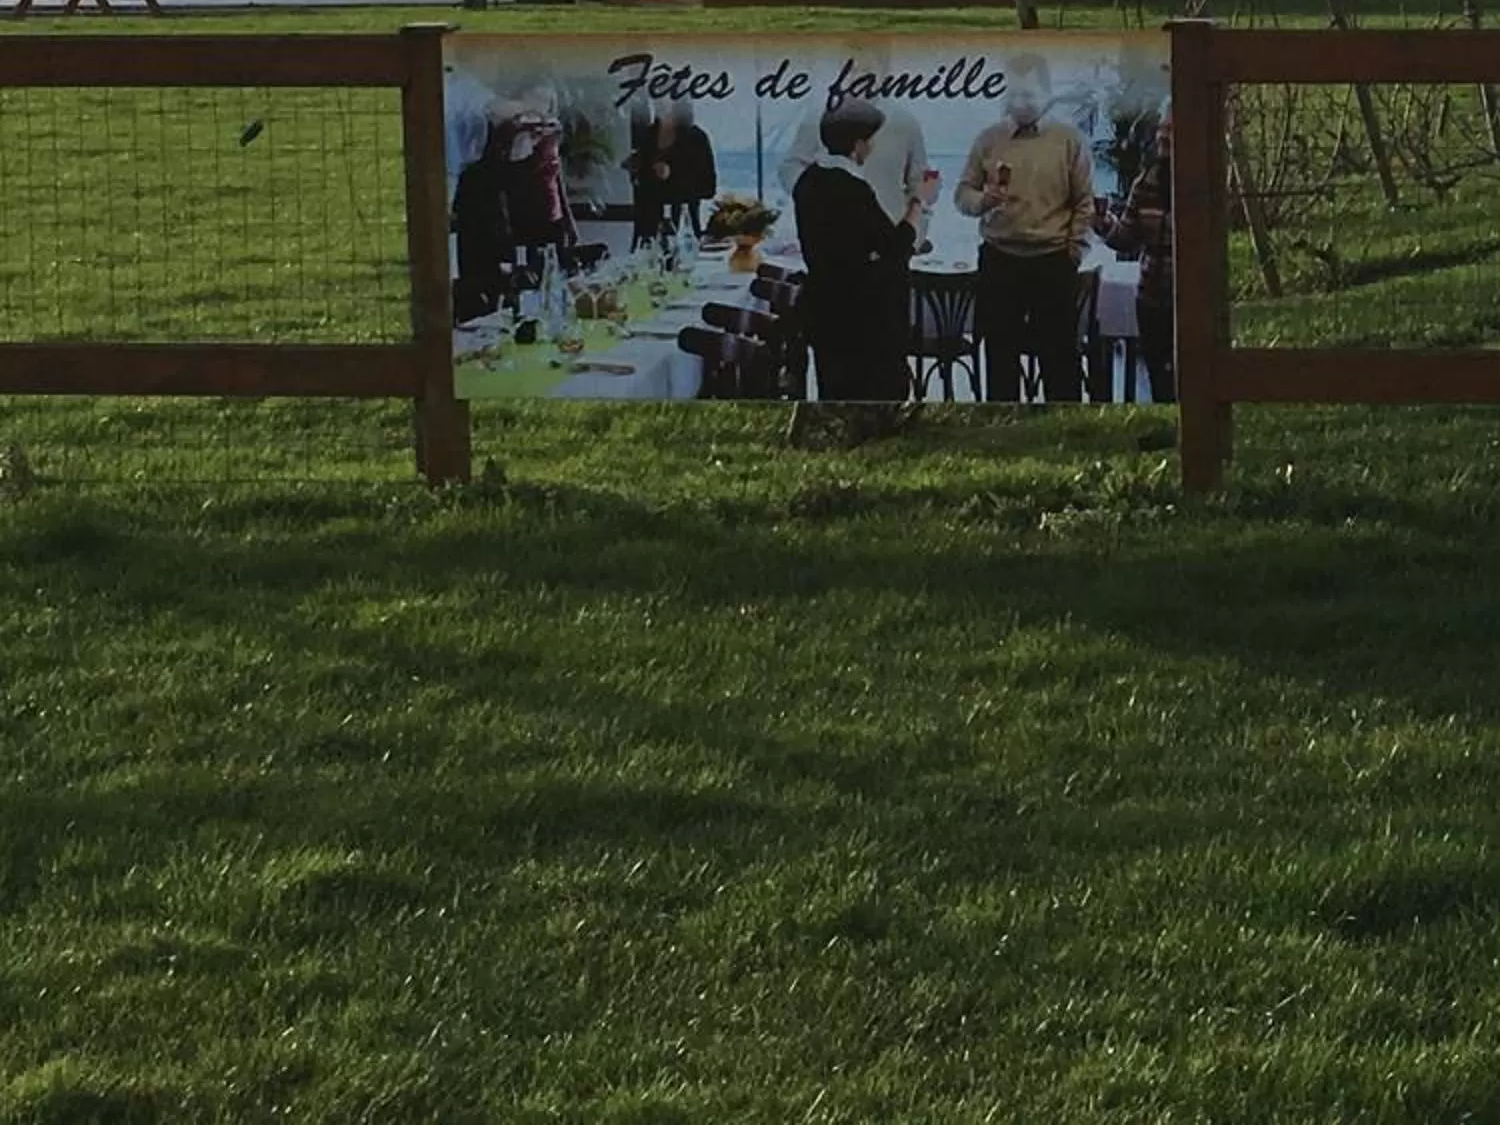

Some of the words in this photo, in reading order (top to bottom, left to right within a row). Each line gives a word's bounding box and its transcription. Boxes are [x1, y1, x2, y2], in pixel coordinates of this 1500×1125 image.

[607, 53, 735, 107] Fêtes
[755, 58, 810, 100] de
[826, 55, 1008, 113] famille
